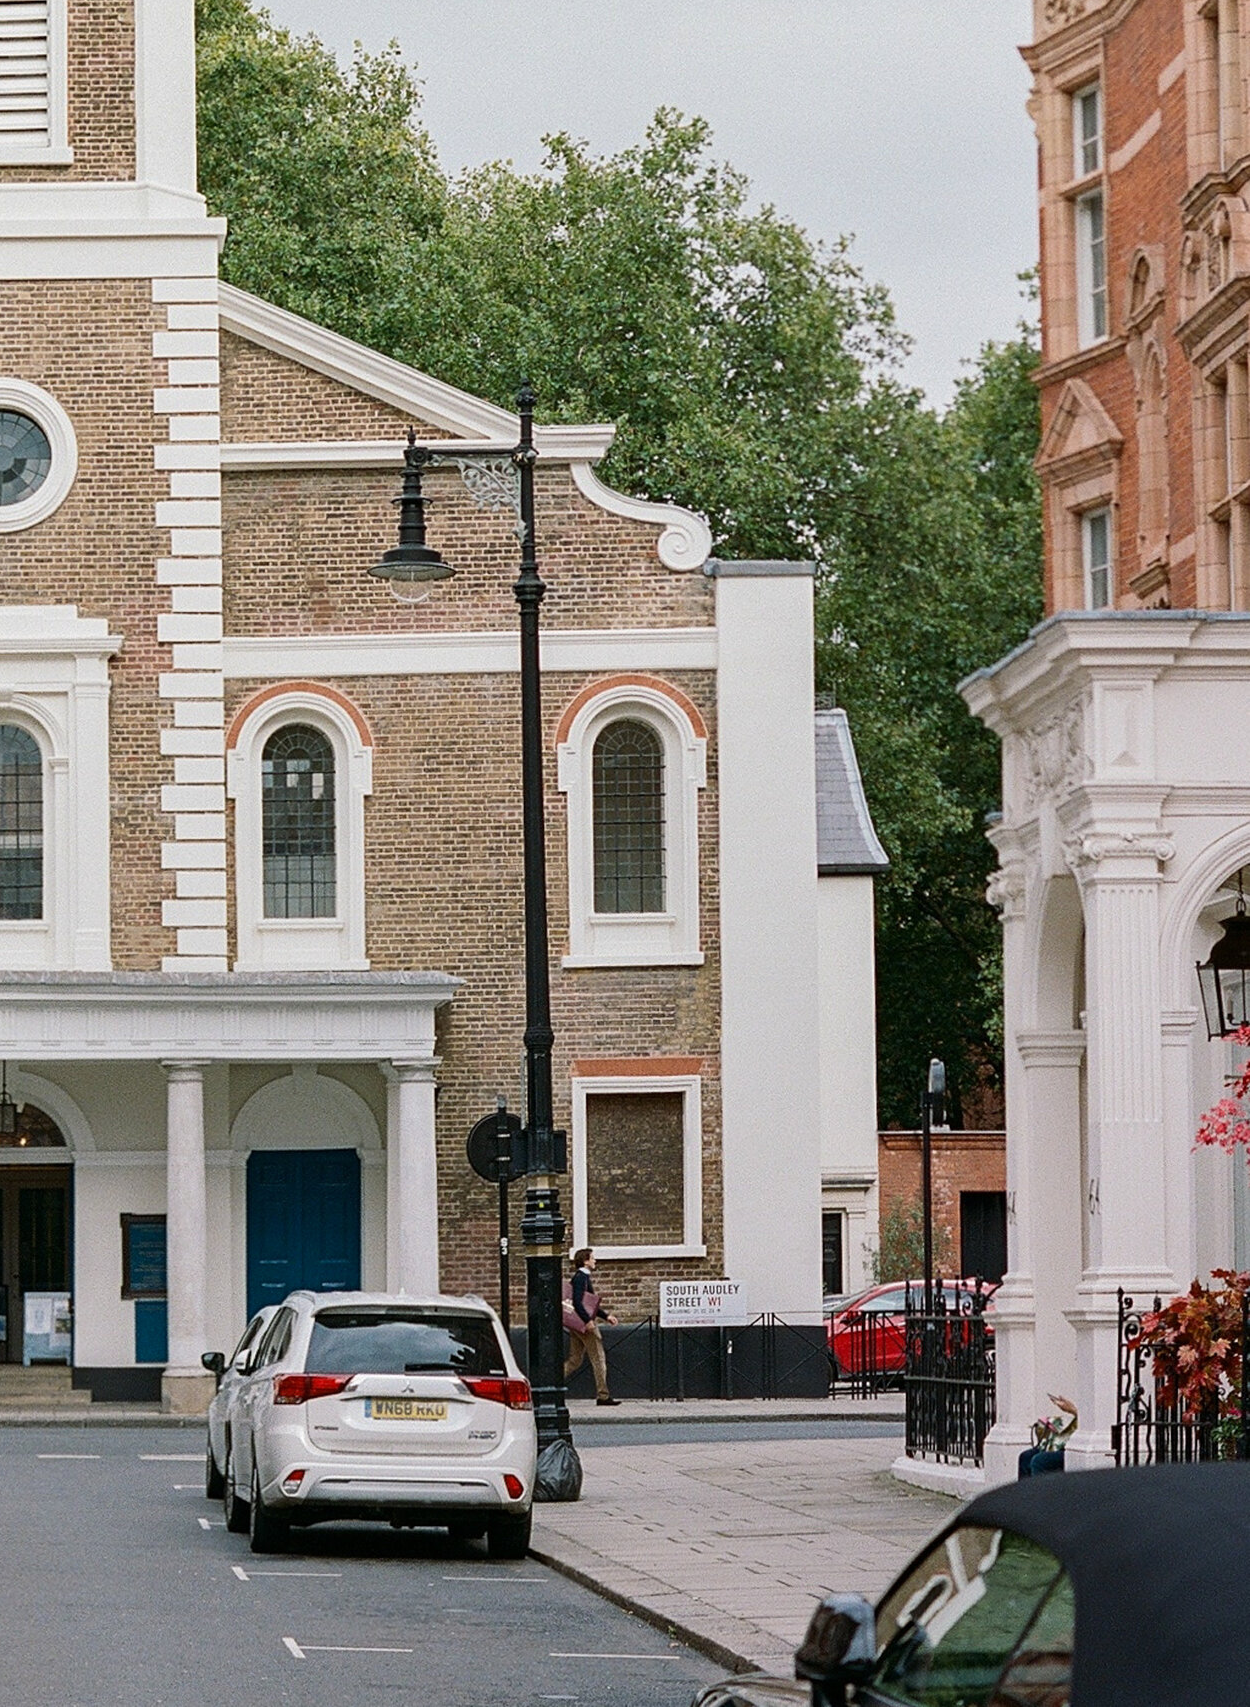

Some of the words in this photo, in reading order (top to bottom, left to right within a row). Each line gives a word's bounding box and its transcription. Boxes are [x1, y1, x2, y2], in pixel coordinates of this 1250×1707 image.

[666, 1285, 699, 1296] SOUTH
[703, 1284, 740, 1295] AUDLEY
[666, 1297, 702, 1308] STREET
[707, 1296, 722, 1306] W1
